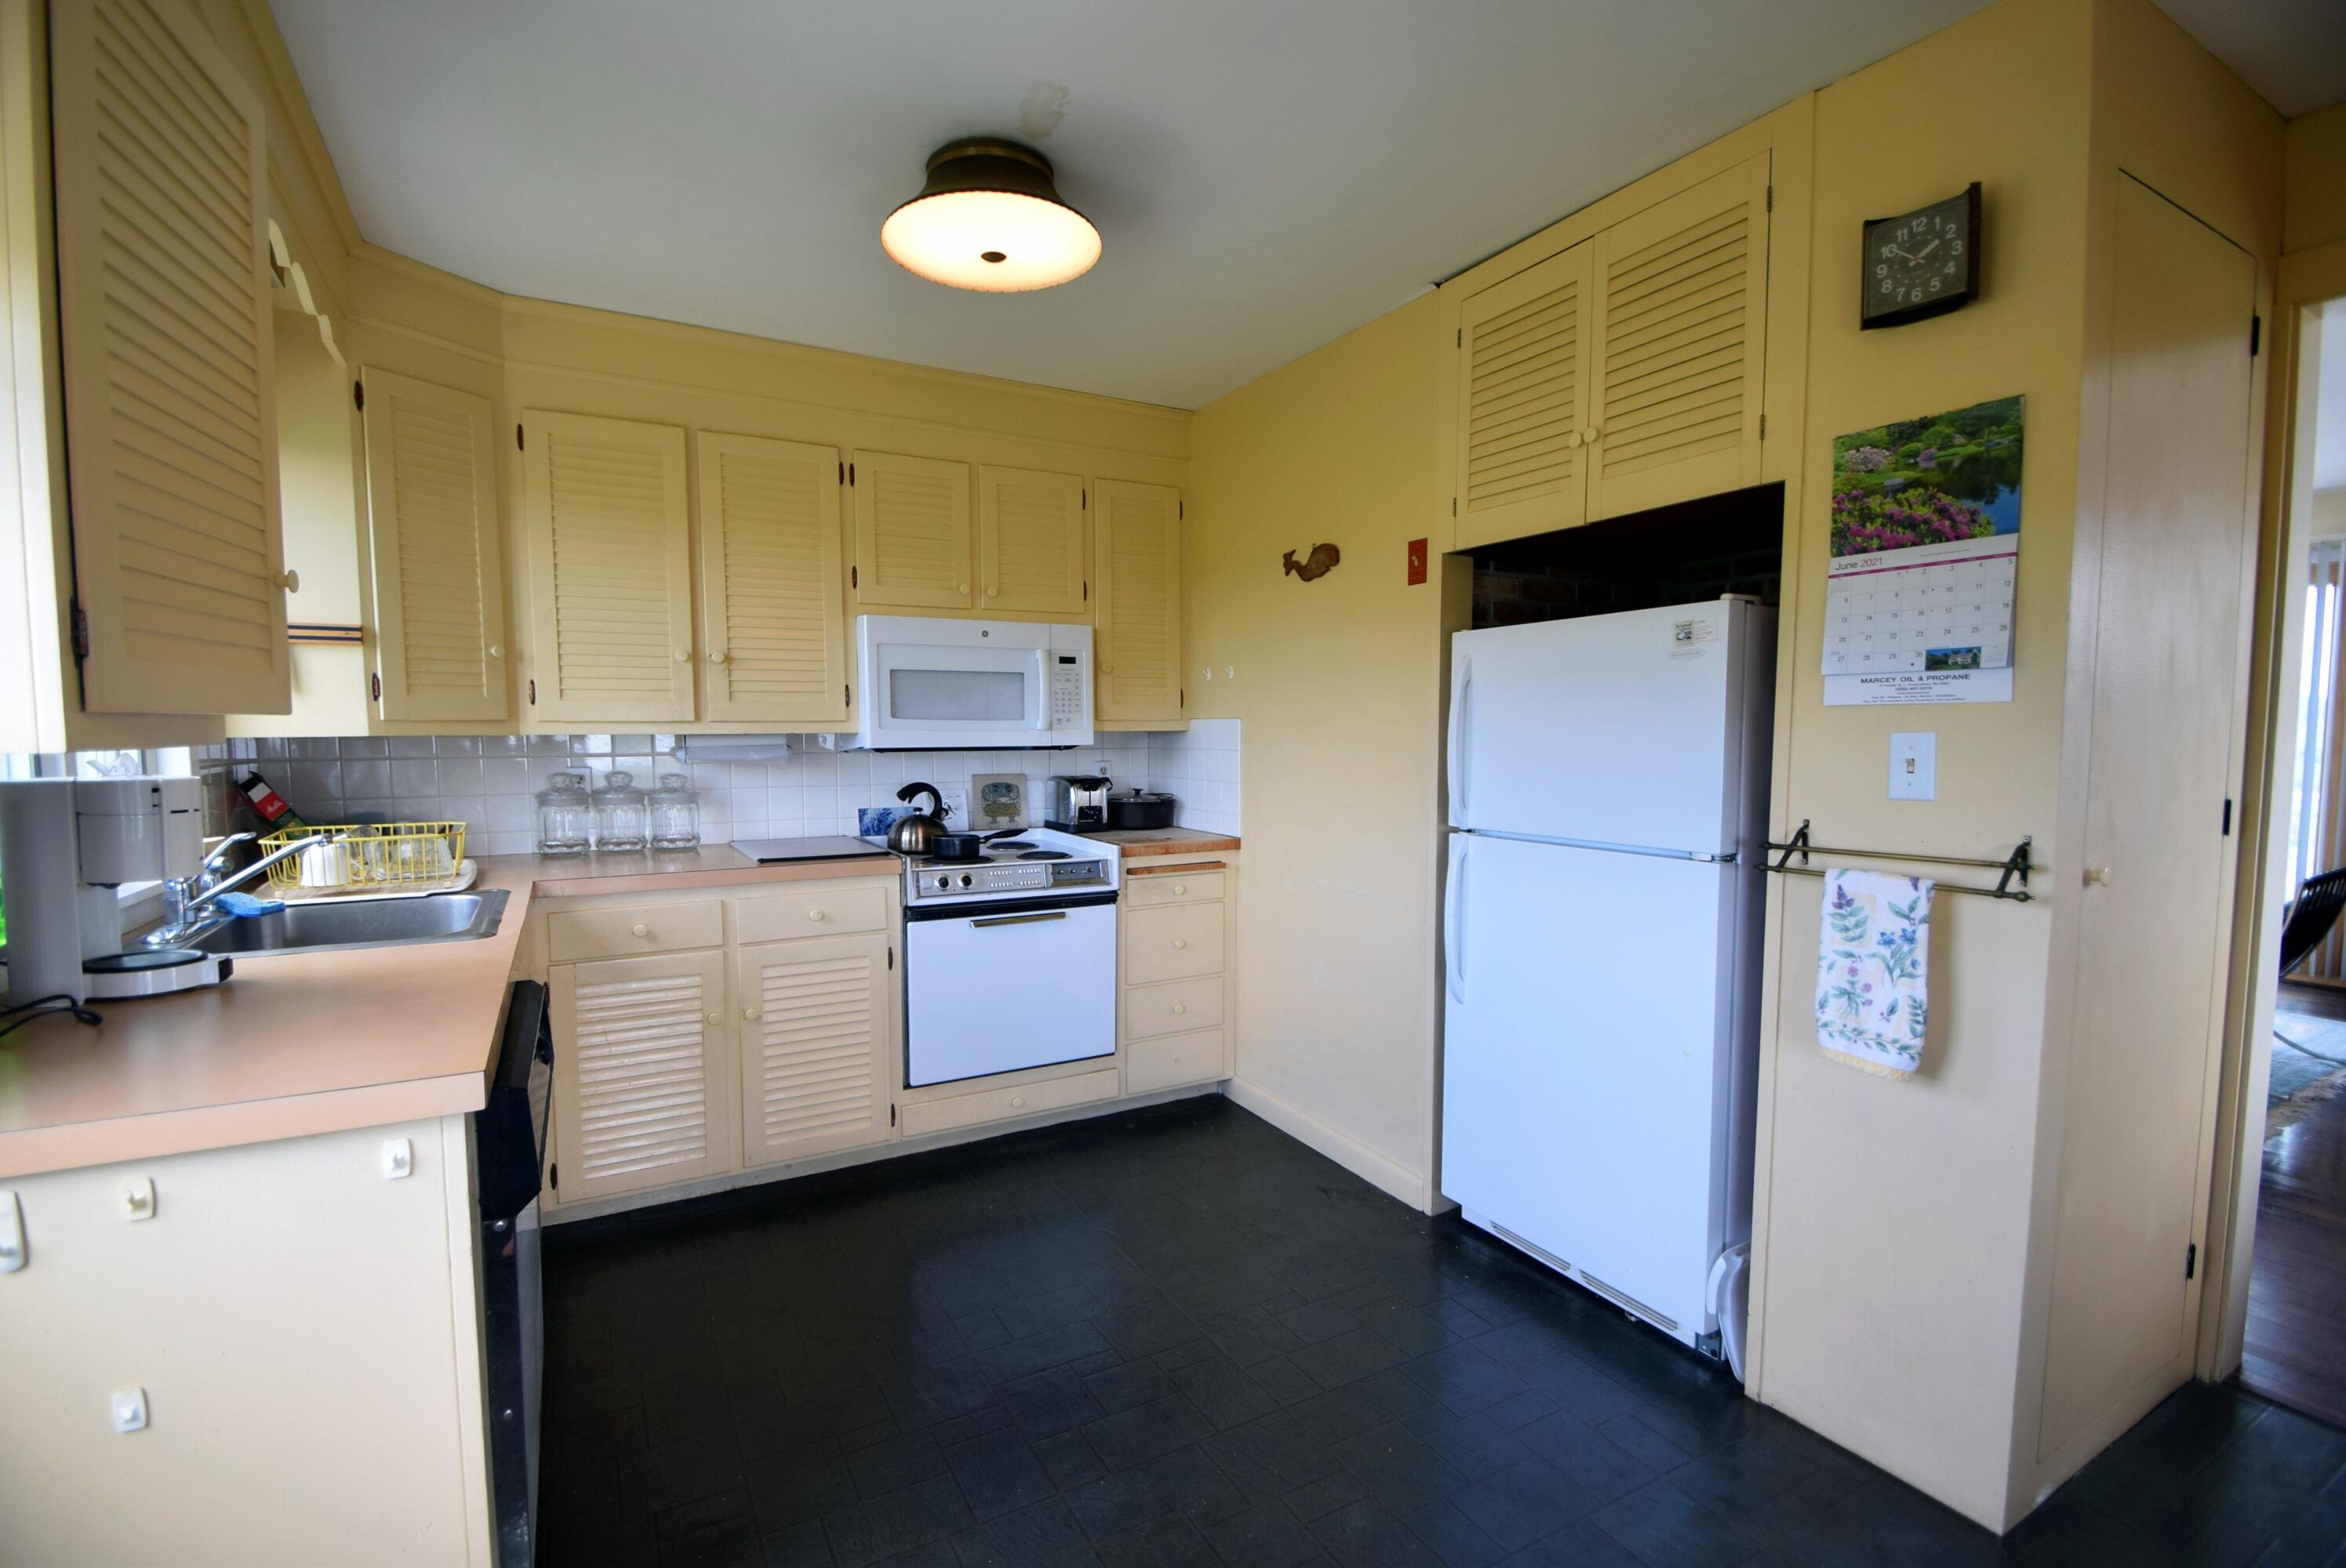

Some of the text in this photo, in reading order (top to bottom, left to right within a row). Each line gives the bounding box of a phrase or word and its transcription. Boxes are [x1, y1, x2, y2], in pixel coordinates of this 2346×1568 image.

[1911, 216, 1927, 233] 12
[1934, 216, 1941, 230] 1
[1896, 227, 1908, 242] 11
[1945, 224, 1956, 239] 2
[1880, 243, 1897, 260] 10
[1951, 240, 1963, 256] 3
[1876, 263, 1887, 278] 9
[1944, 260, 1956, 274] 4
[1881, 279, 1892, 293] 8
[1929, 277, 1941, 292] 5
[1896, 287, 1906, 302] 7
[1911, 288, 1922, 302] 6
[1834, 557, 1883, 571] June 2021
